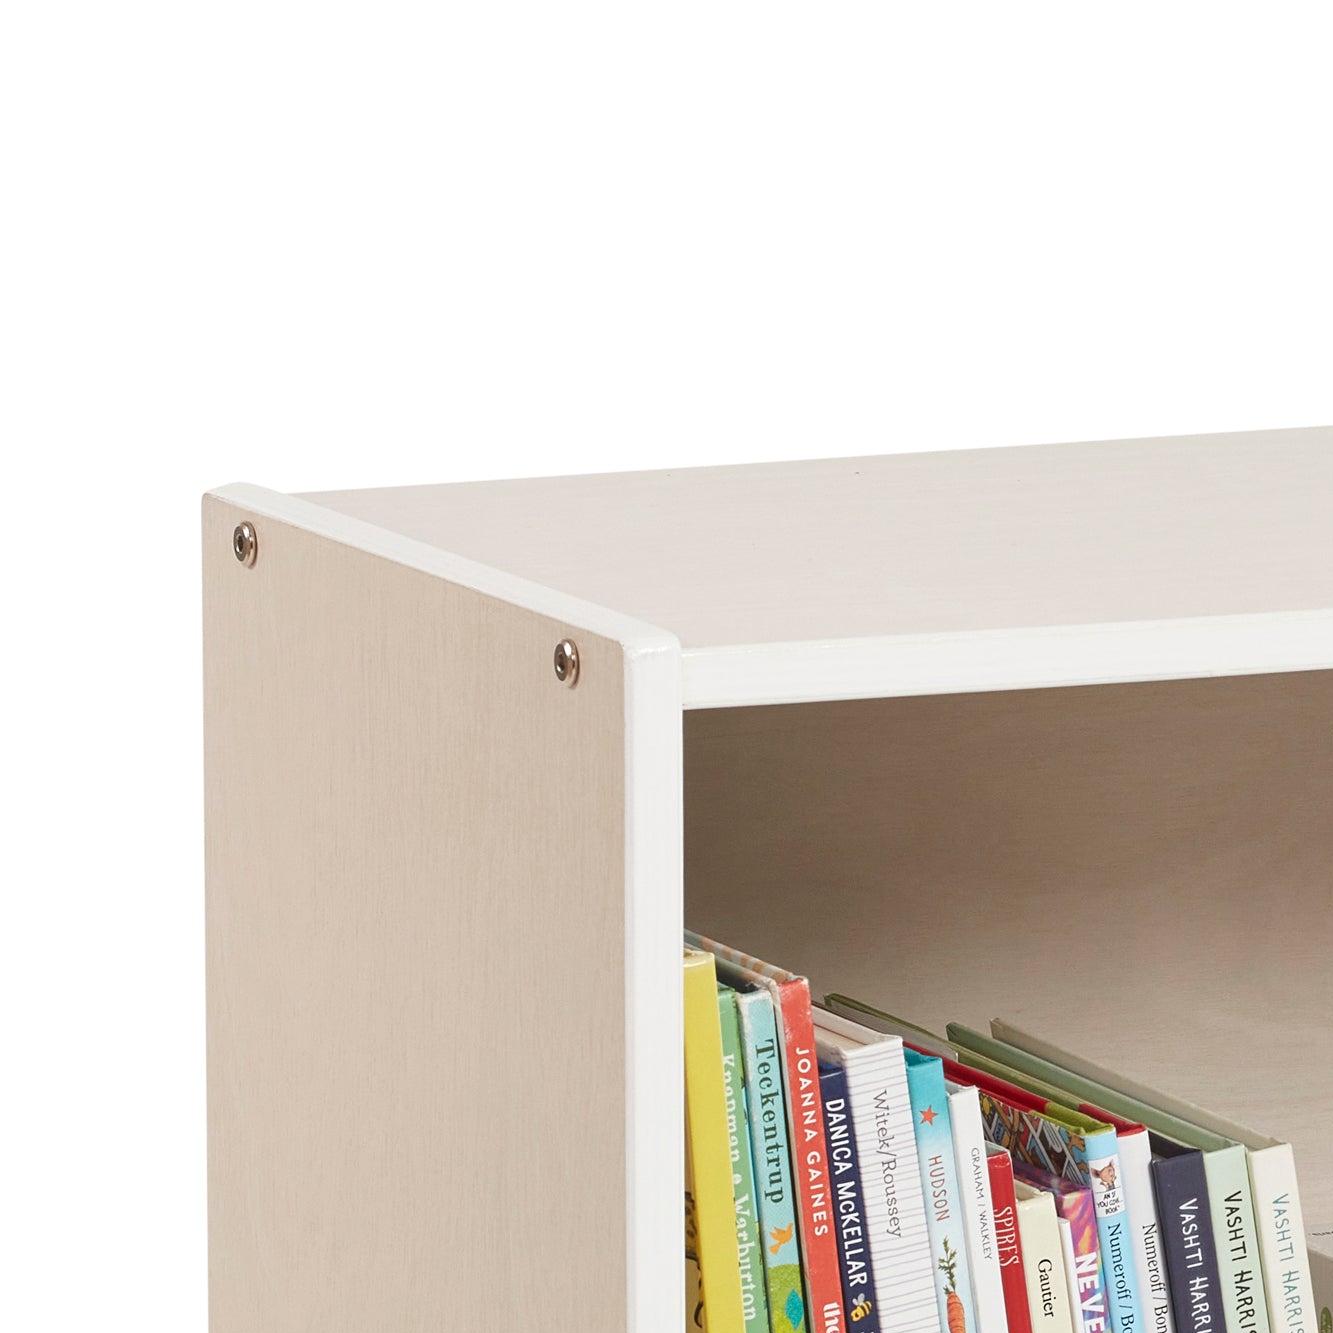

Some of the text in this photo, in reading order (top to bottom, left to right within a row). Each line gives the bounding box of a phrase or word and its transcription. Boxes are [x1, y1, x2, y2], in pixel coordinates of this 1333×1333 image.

[755, 1038, 783, 1204] Teckentrup
[796, 1048, 828, 1236] JOANNA GAINES
[825, 1098, 852, 1175] DANICA
[874, 1089, 901, 1238] Witek/Roussey
[928, 1155, 949, 1222] HUDSON
[971, 1148, 992, 1260] GRAHAM WALKLEY
[993, 1206, 1020, 1267] SPIRES
[1179, 1198, 1202, 1269] VASHTI
[1272, 1193, 1294, 1262] VASHTI
[1037, 1258, 1054, 1318] Gautier
[1108, 1223, 1132, 1302] Numeroff
